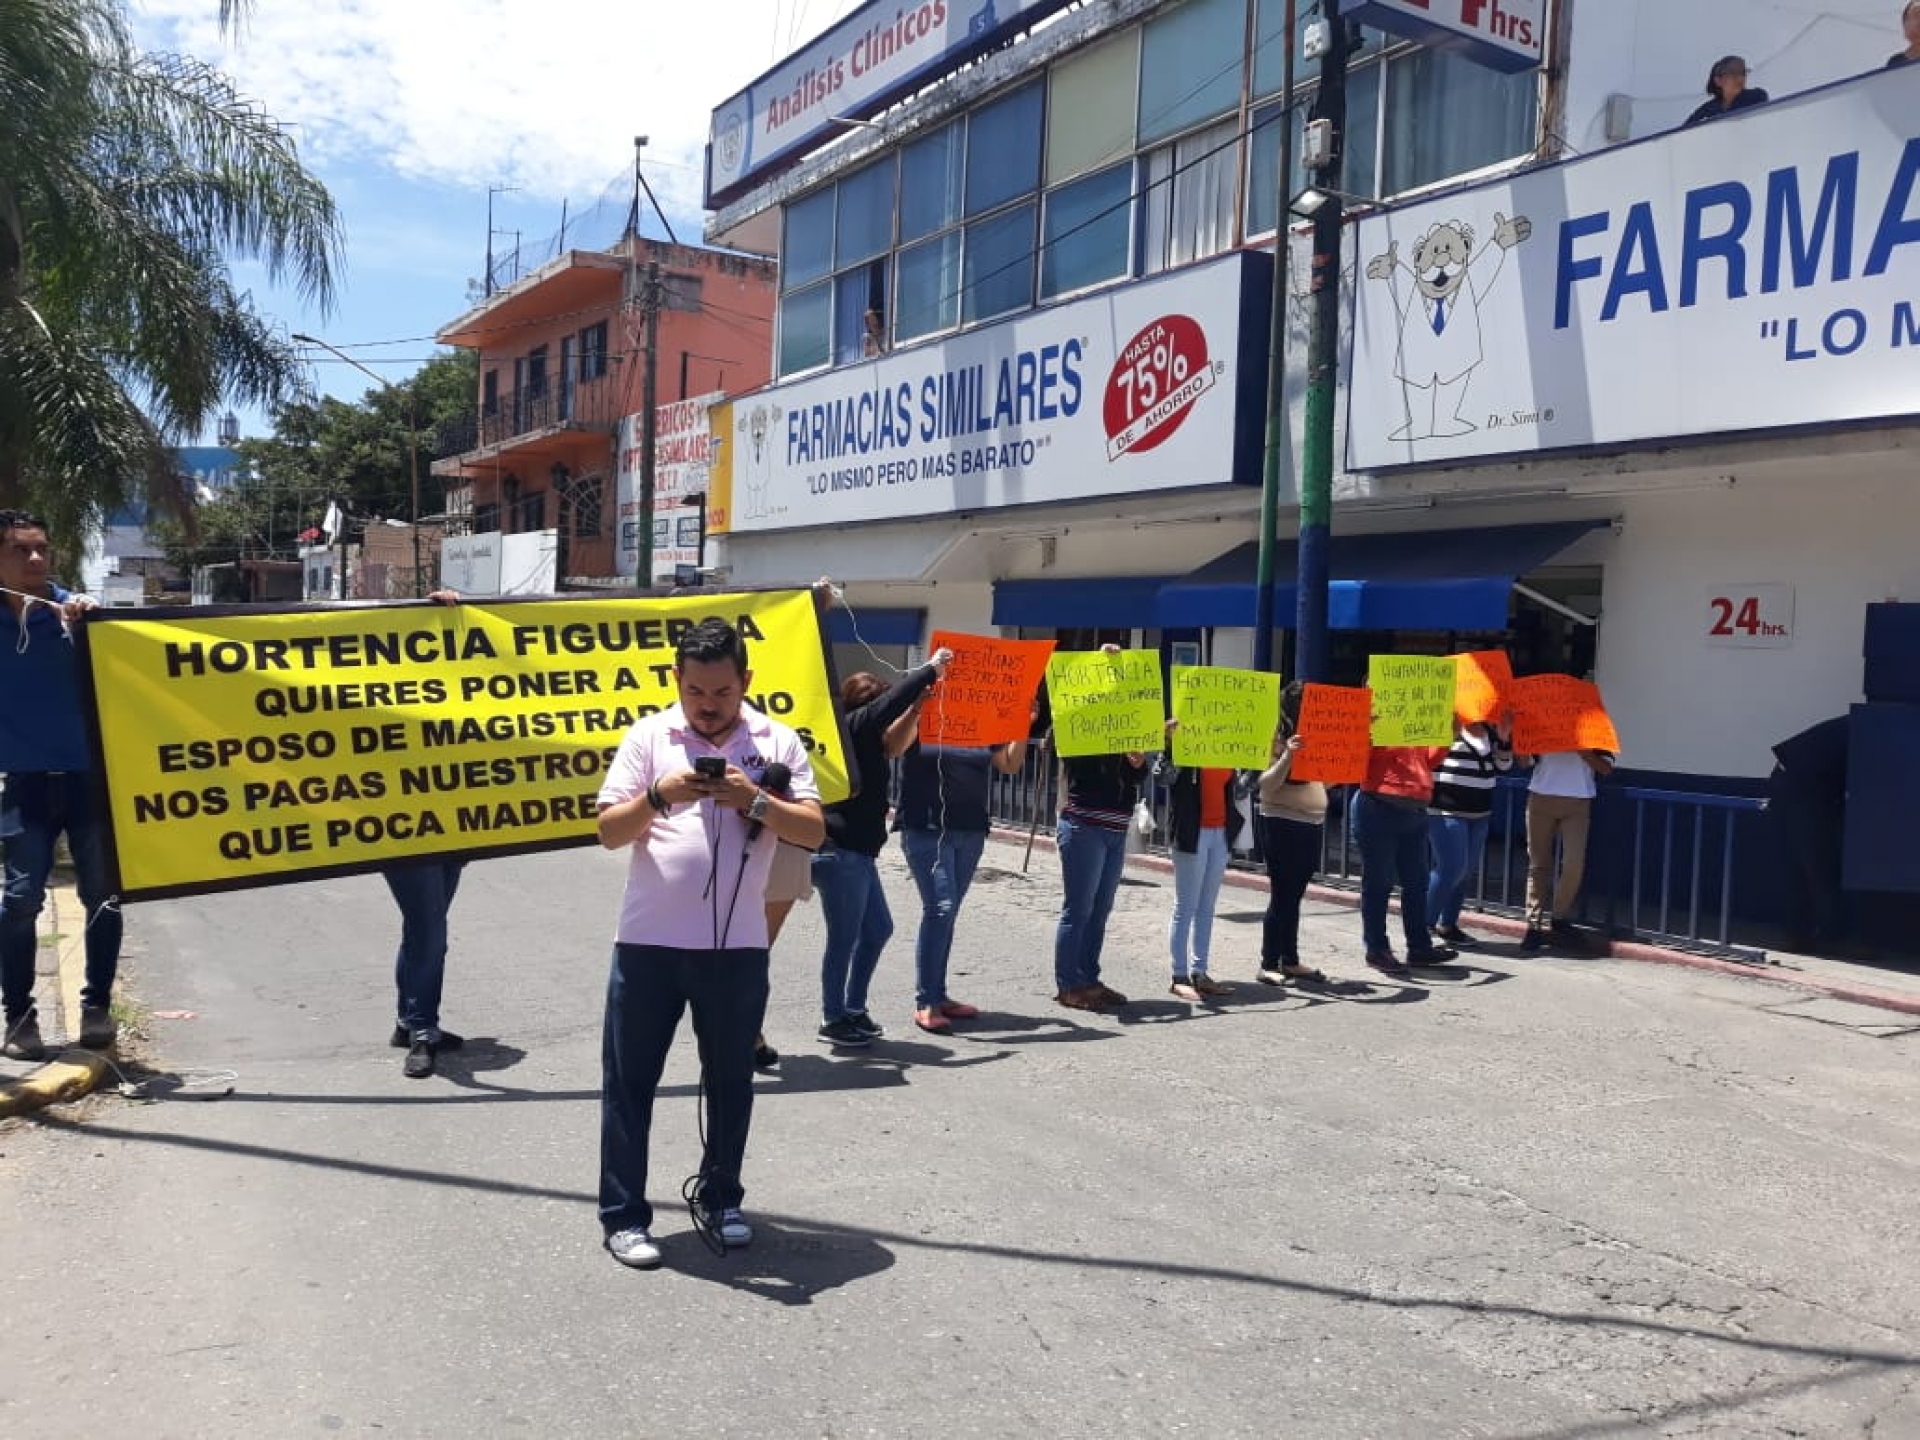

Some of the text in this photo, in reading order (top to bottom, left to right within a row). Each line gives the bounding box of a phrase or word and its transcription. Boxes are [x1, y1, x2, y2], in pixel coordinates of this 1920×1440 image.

[766, 0, 946, 133] Análisis Clínicos
[1117, 332, 1188, 421] 75%
[1125, 325, 1165, 365] HASTA
[788, 338, 1082, 466] FARMACIAS SIMILARES
[1116, 376, 1203, 451] DE AHORRO
[831, 465, 874, 493] MISMO
[877, 458, 918, 487] PERO
[922, 453, 956, 480] MAS
[165, 614, 765, 678] HORTENCIA FIGUERA
[255, 678, 447, 717] QUIERES
[462, 669, 600, 701] PONER
[613, 667, 640, 691] A
[157, 730, 336, 773] ESPOSO
[351, 723, 407, 754] DE
[133, 787, 229, 823] NOS
[244, 771, 386, 811] PAGAS
[219, 793, 598, 861] QUE POCA MADRE
